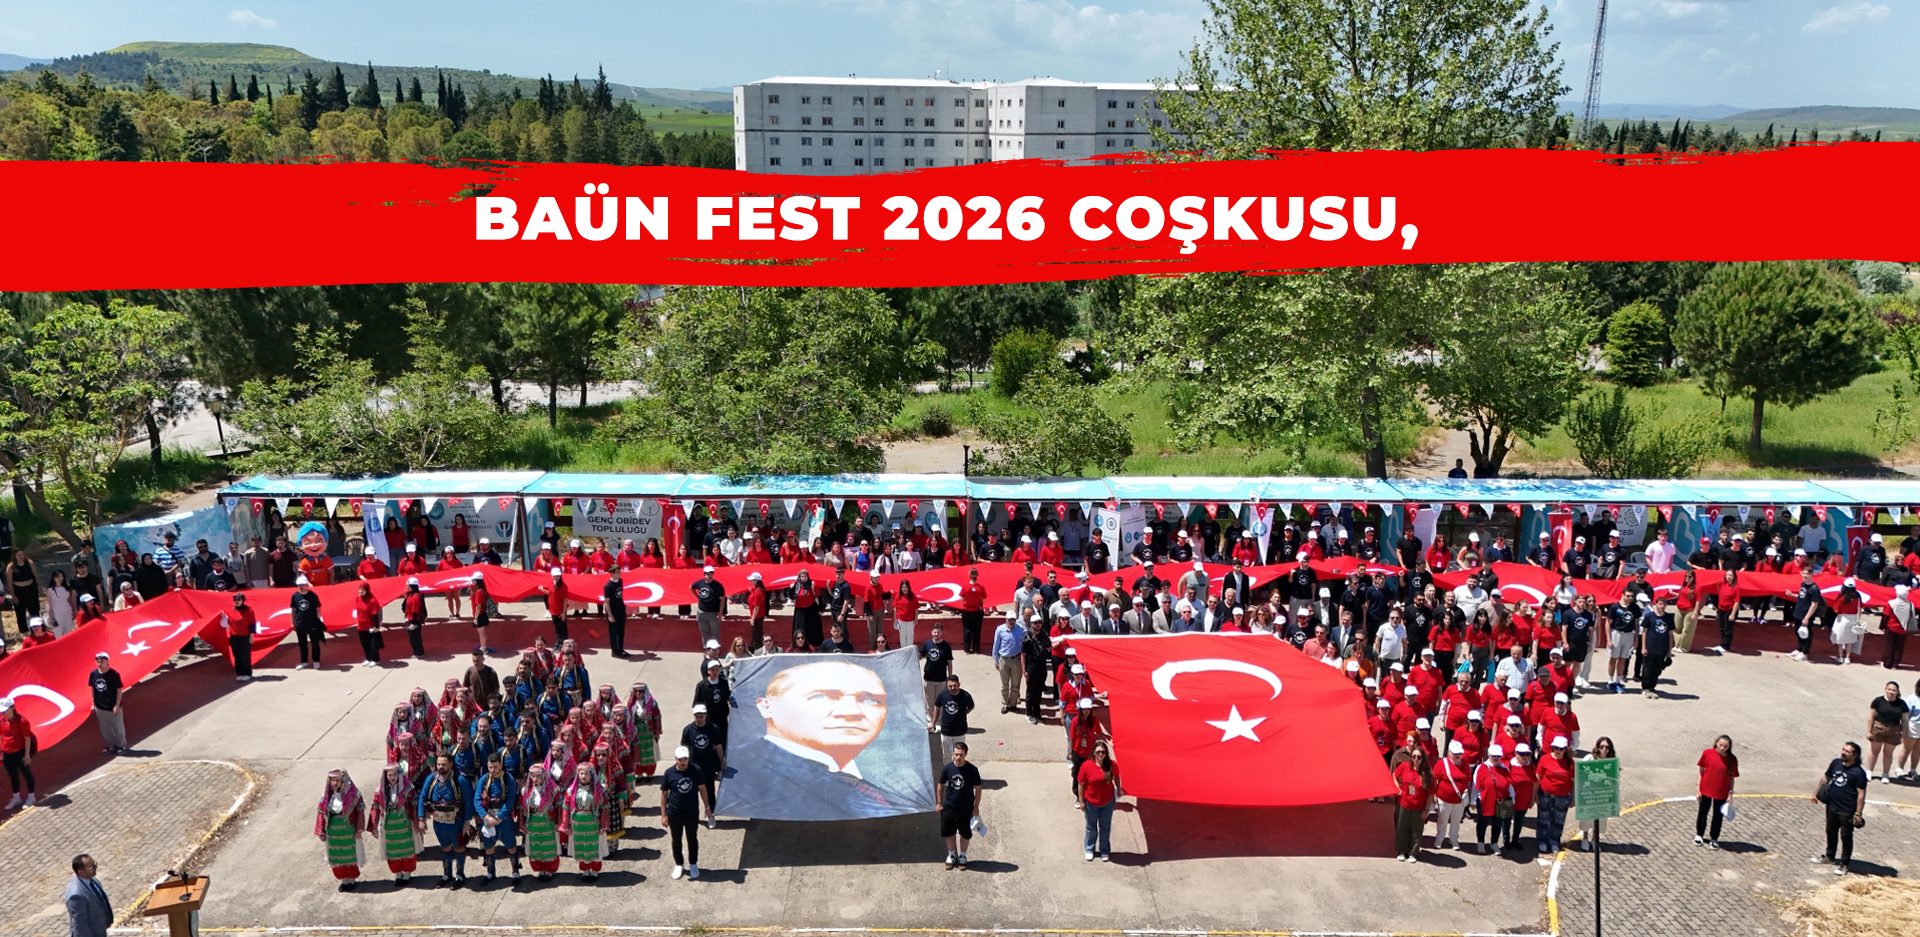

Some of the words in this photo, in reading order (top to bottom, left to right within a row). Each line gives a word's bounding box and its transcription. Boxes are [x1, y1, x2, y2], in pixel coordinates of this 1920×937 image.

[587, 516, 614, 524] GENÇ
[616, 517, 651, 525] OBİDEV
[591, 525, 647, 534] TOPLULUĞU
